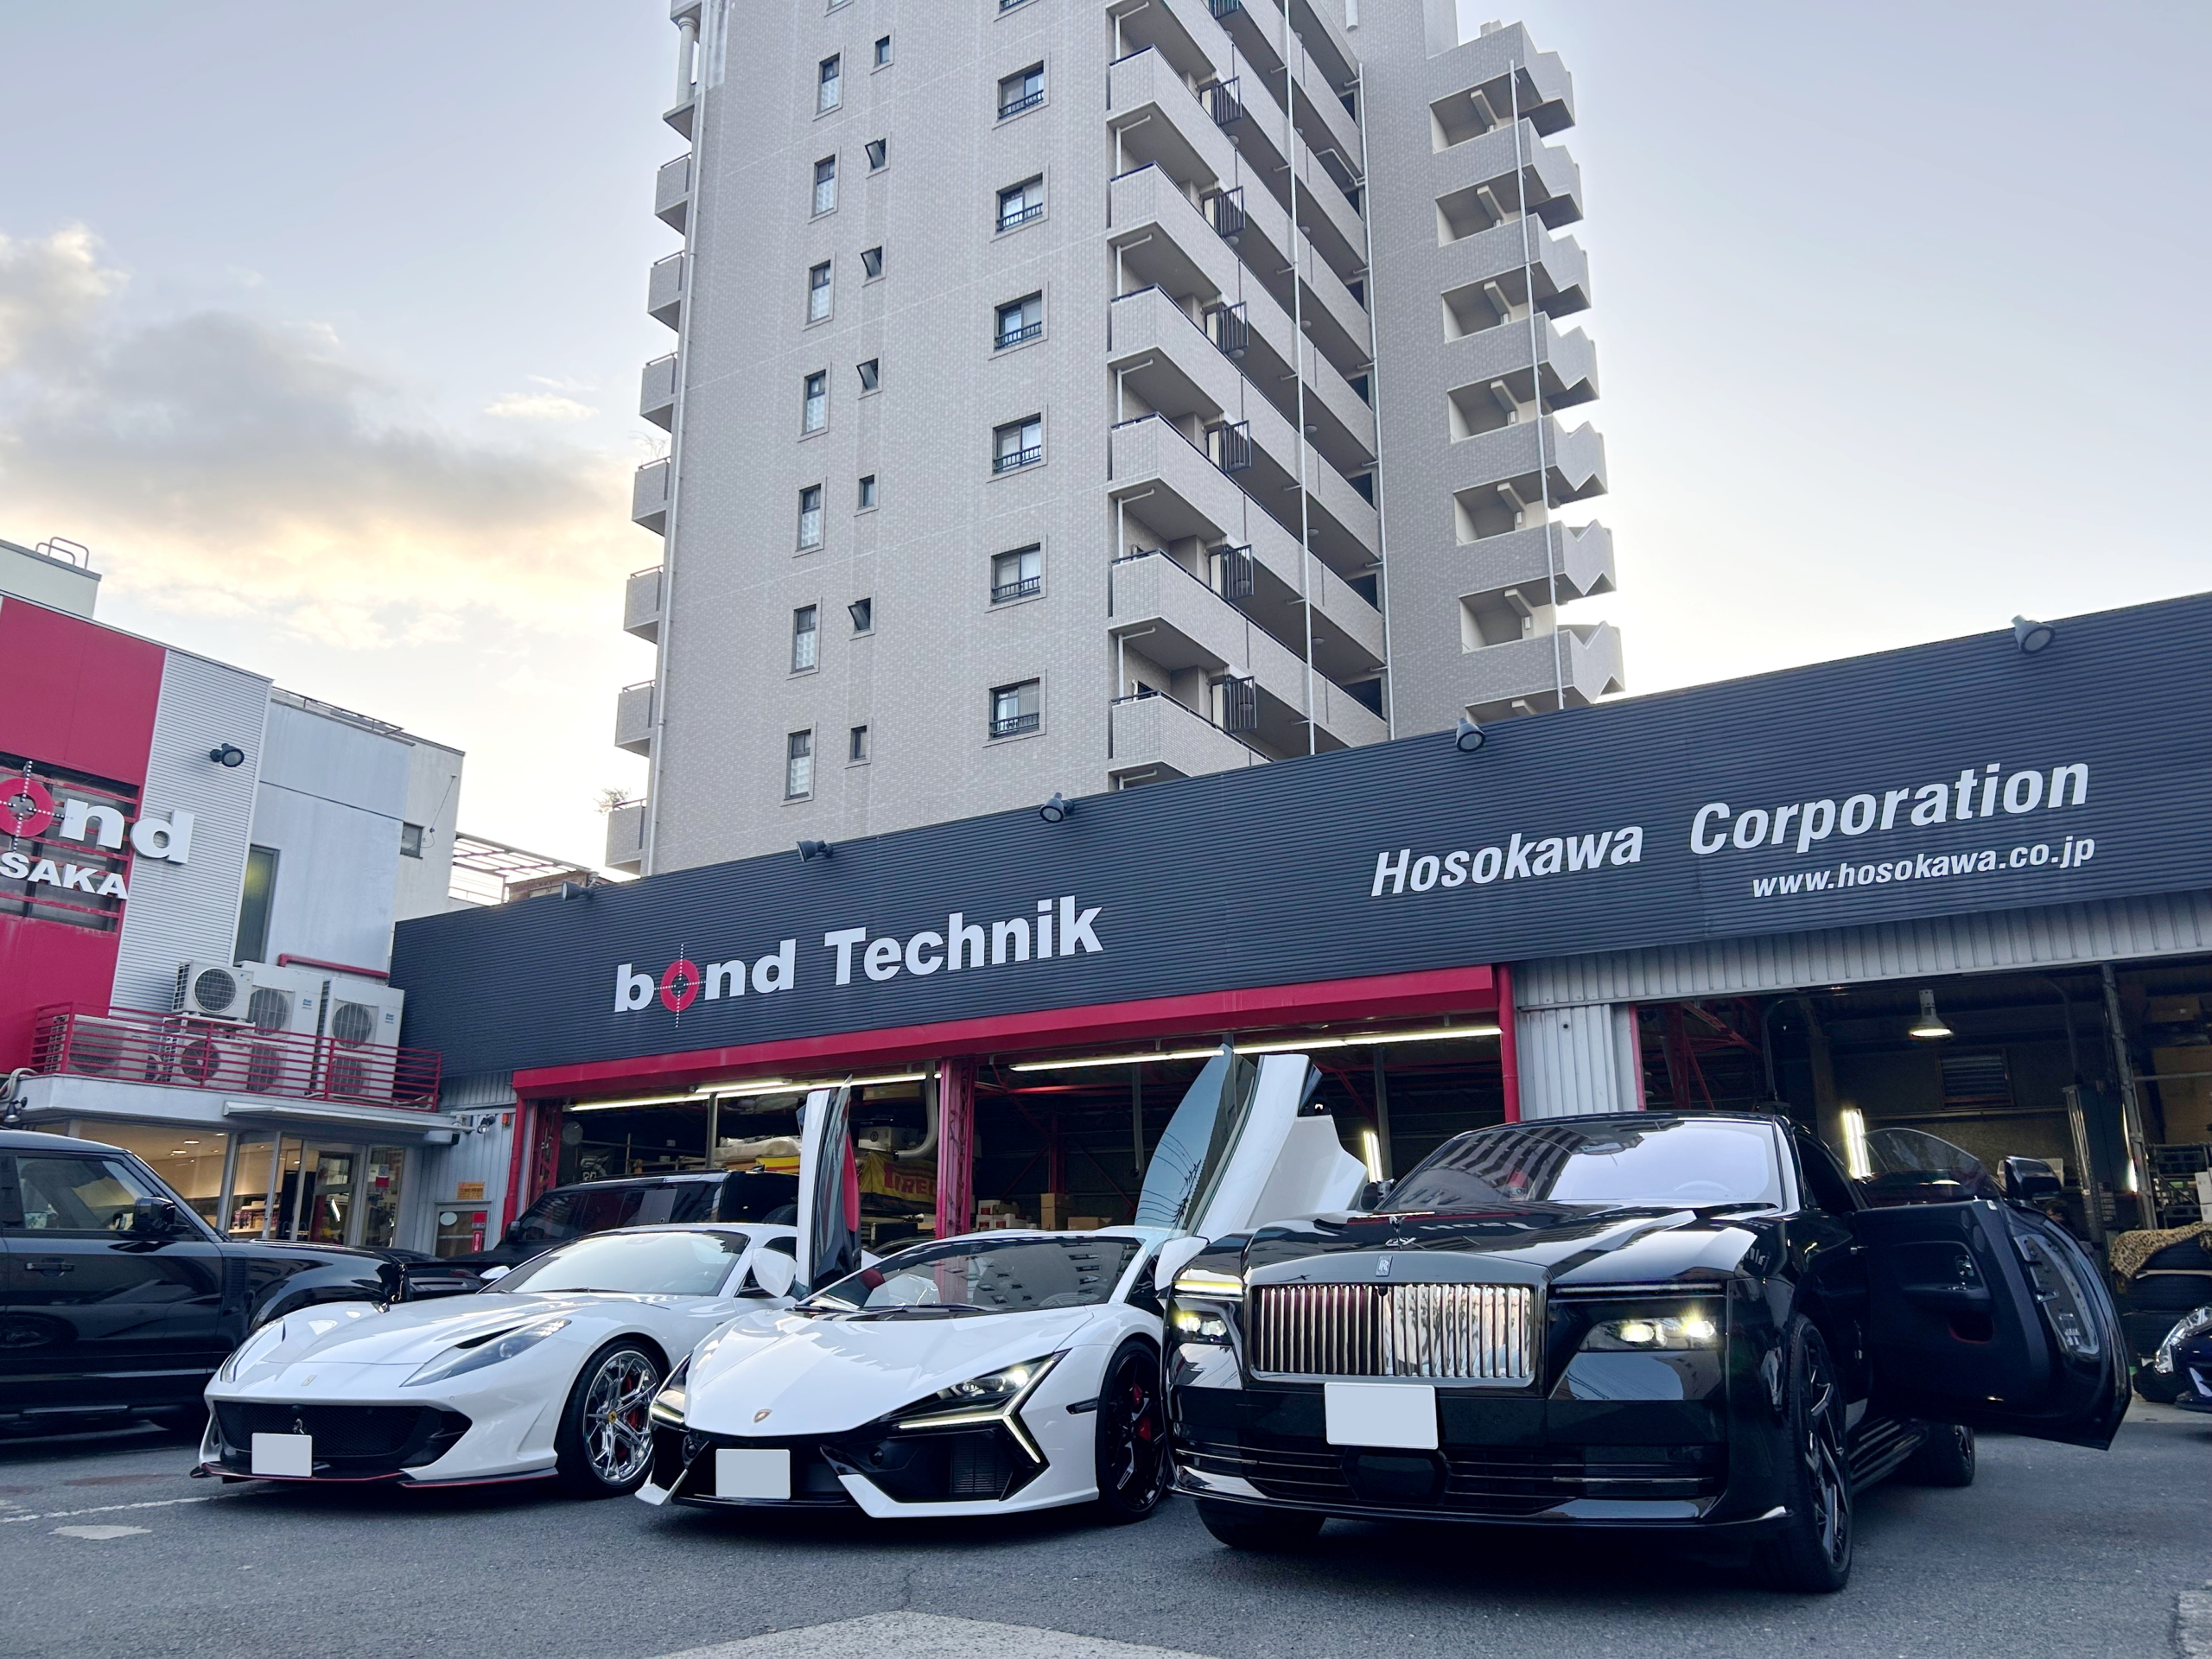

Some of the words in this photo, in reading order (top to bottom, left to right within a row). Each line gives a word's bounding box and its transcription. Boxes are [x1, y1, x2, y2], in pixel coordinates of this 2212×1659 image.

[1370, 826, 1643, 897] Hosokawa
[1690, 763, 2089, 854] Corporation
[1752, 836, 2095, 897] www.hosokawa.co.jp
[0, 851, 128, 899] SAKA
[614, 938, 797, 1013] bond
[823, 895, 1103, 985] Technik
